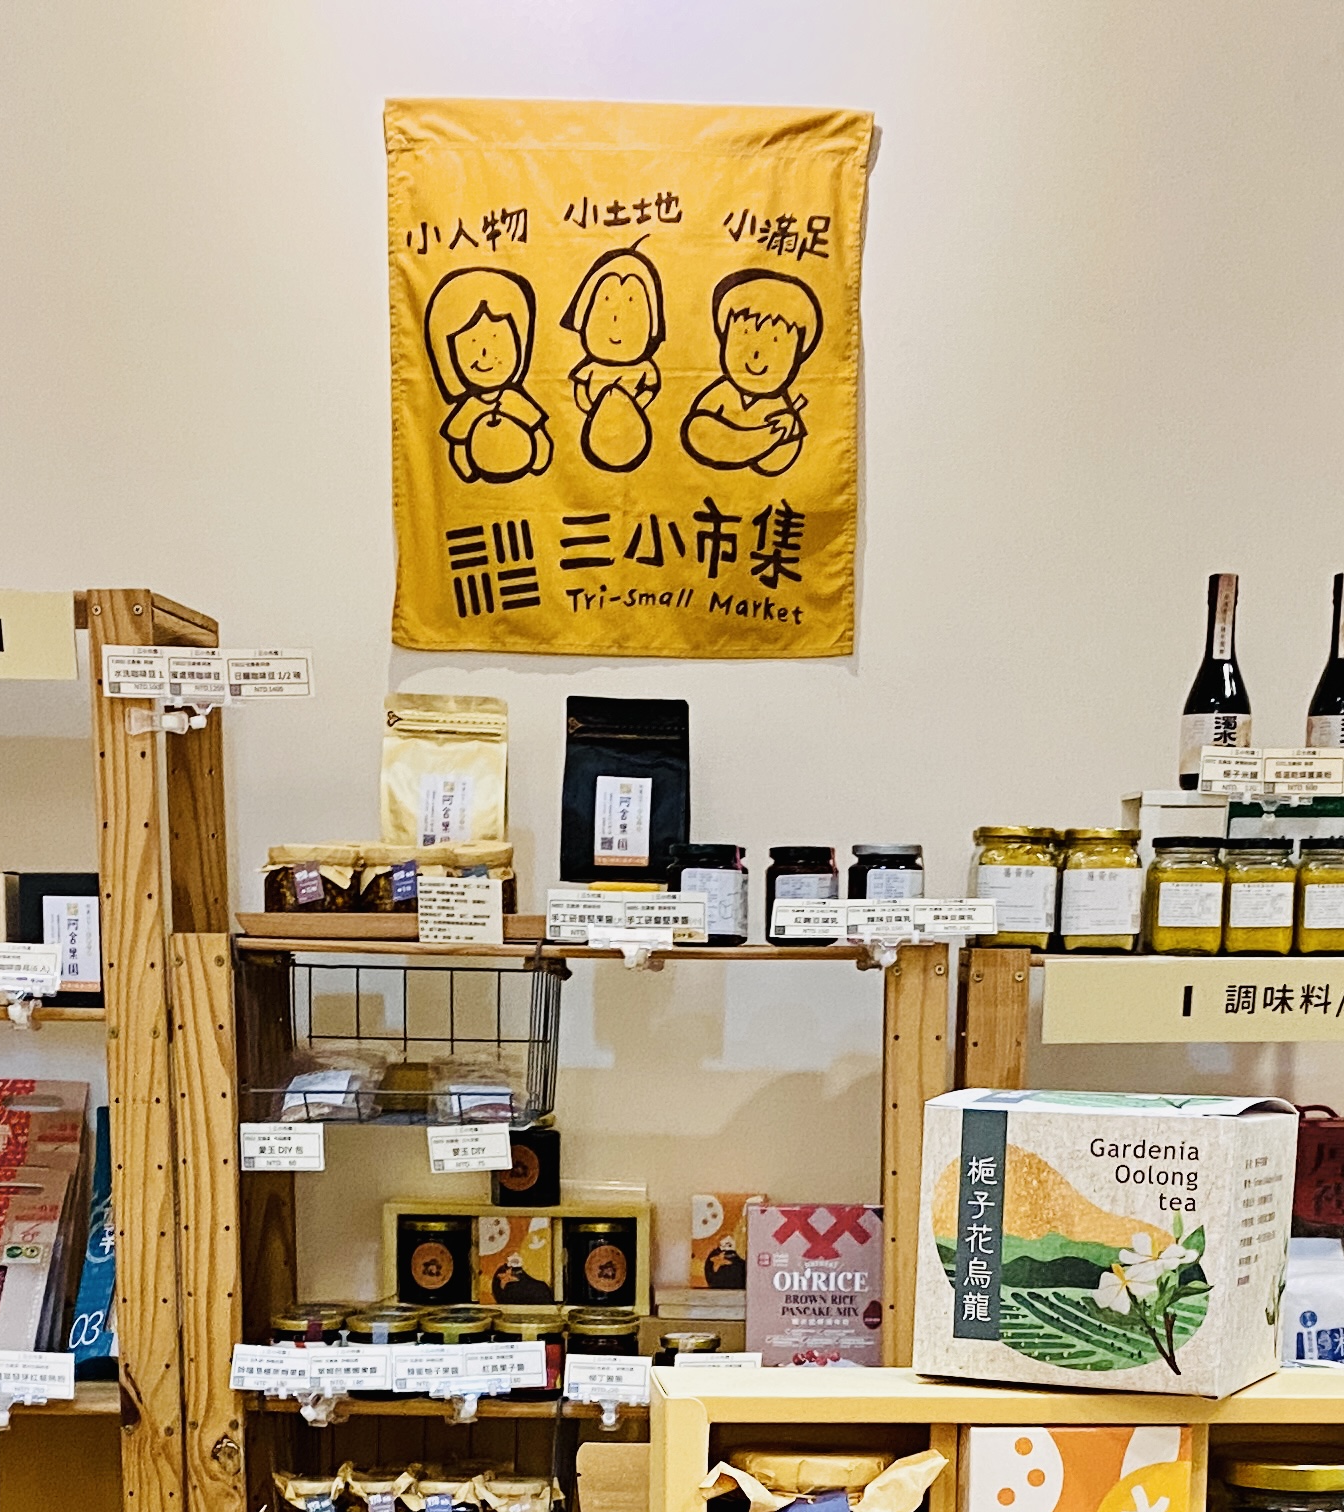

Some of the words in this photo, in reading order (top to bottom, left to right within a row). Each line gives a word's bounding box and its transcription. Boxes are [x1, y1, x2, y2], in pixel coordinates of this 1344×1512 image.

[563, 191, 684, 229] 小土地
[407, 208, 529, 255] 小人物
[722, 207, 834, 261] 小滿足
[560, 496, 807, 590] 三小市集
[566, 584, 695, 614] Tri-Small
[711, 590, 806, 626] Market
[1214, 716, 1237, 747] 濁水
[1091, 1139, 1199, 1160] Gardenia
[1116, 1165, 1197, 1191] Oolong
[1160, 1194, 1195, 1211] tea
[962, 1155, 998, 1322] 梔子花烏龍
[69, 1310, 104, 1349] 03
